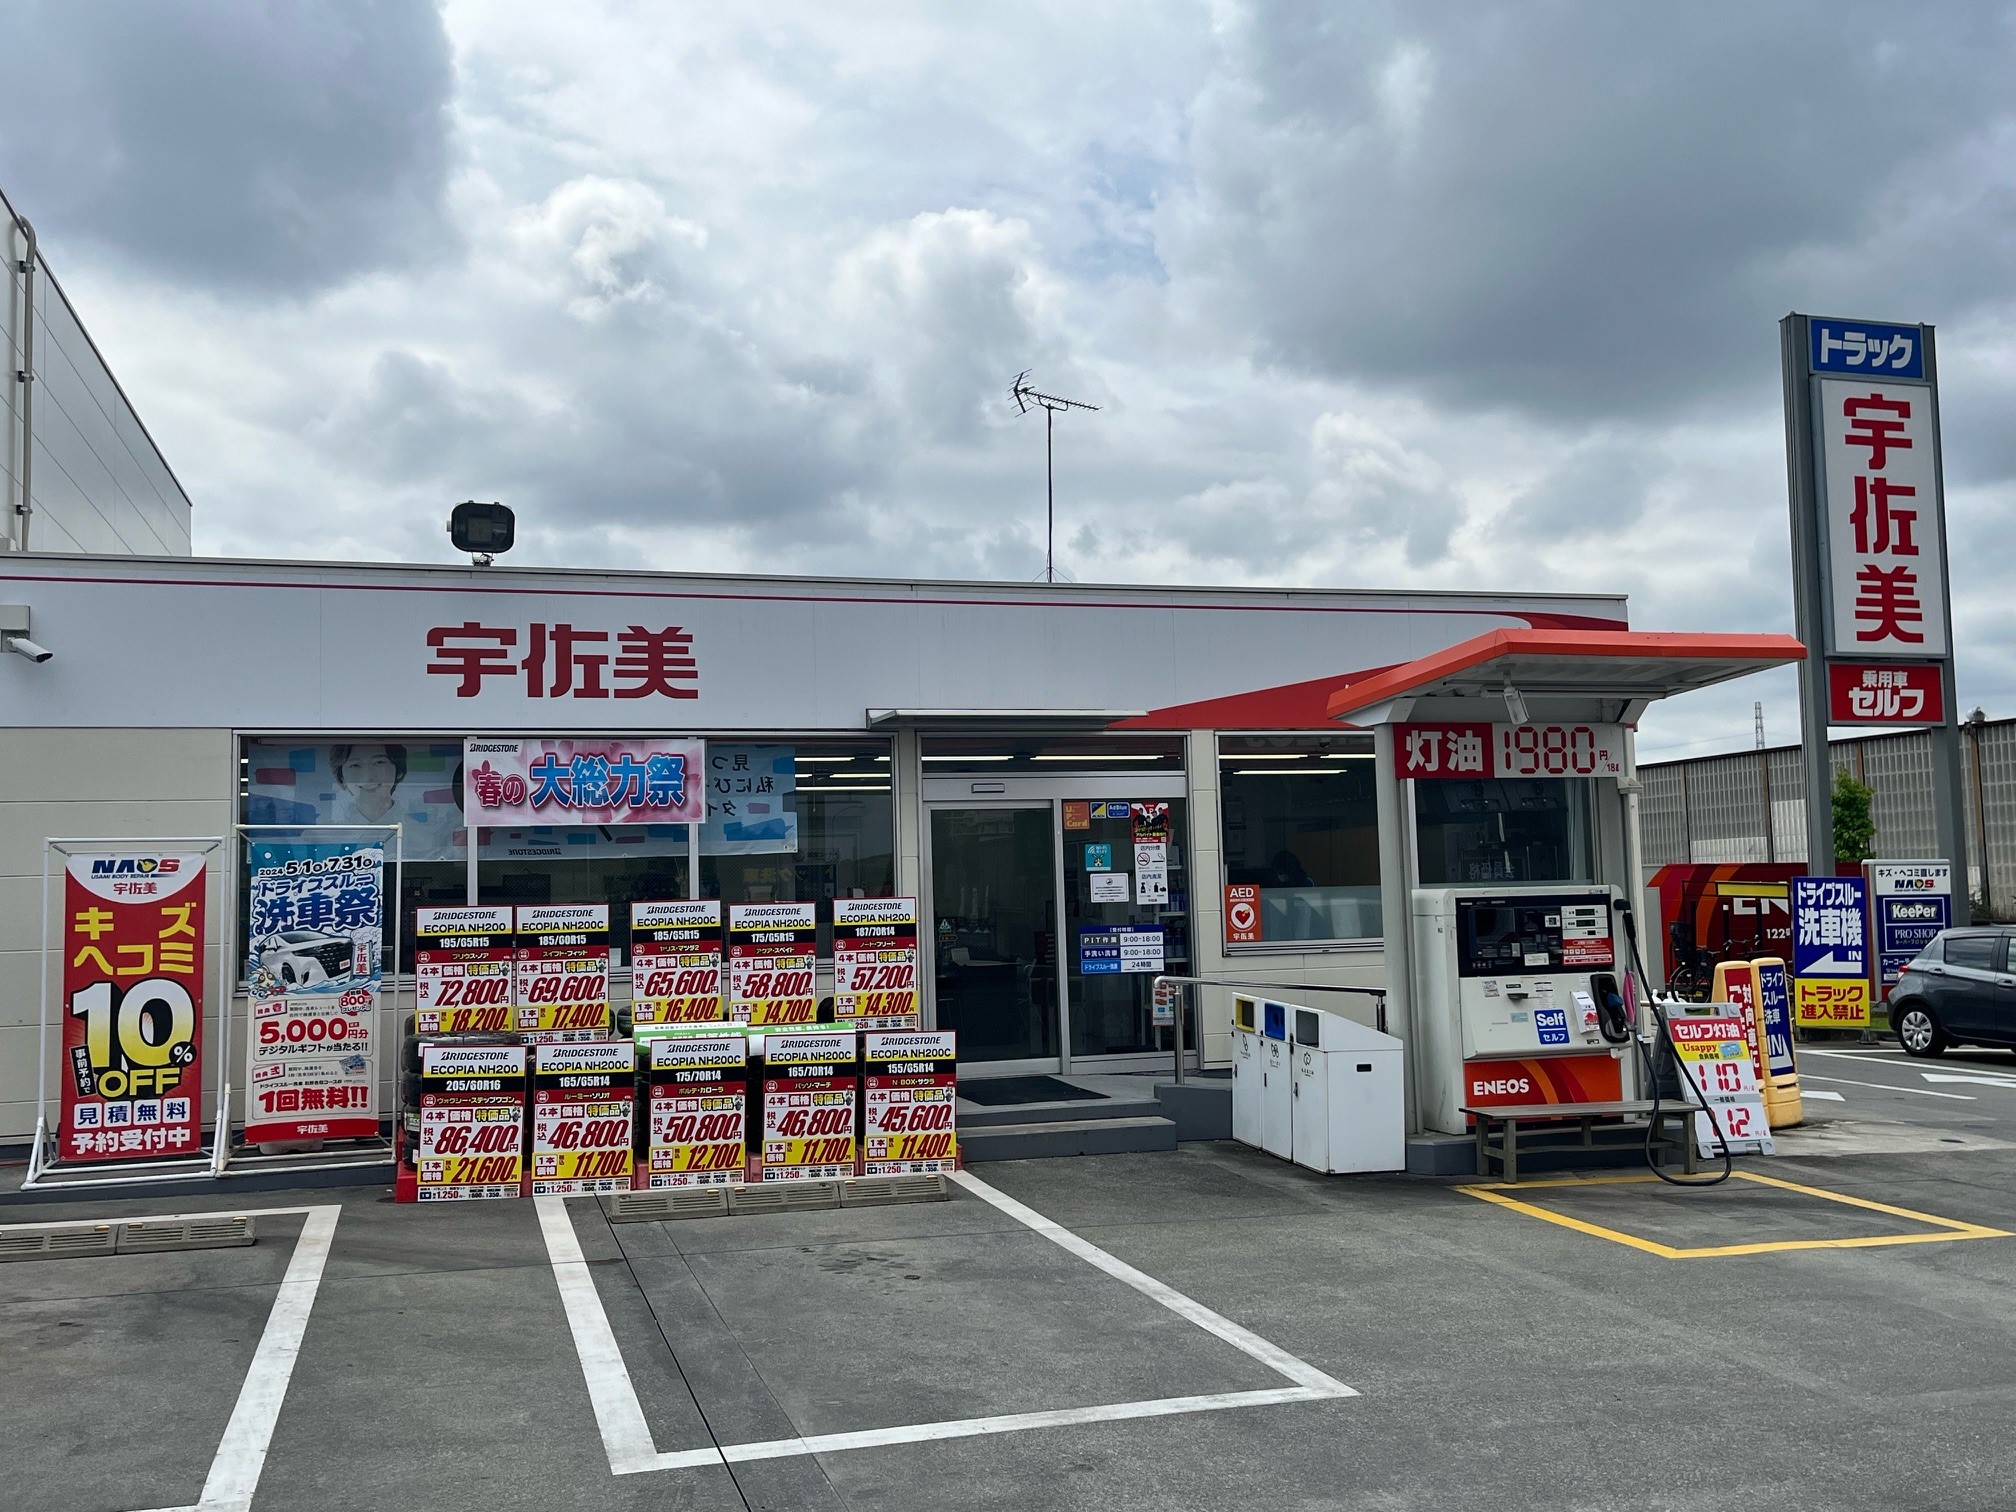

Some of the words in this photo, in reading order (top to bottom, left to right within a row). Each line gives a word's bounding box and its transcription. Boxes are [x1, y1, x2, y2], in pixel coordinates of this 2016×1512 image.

[1820, 328, 1912, 369] トラック
[1843, 393, 1924, 643] 宇佐美
[427, 622, 699, 699] 宇佐美
[1862, 670, 1908, 689] 乗用車
[1849, 687, 1924, 717] セルフ
[469, 743, 519, 753] BRIDGESTONE
[1405, 729, 1484, 772] 灯油
[1504, 726, 1596, 774] 1980
[477, 773, 525, 807] 春の
[531, 754, 686, 808] 大総力祭
[92, 858, 180, 874] NAOS
[260, 868, 284, 876] 2024
[113, 882, 158, 895] 宇佐美
[1895, 879, 1936, 888] NAOS
[1230, 887, 1254, 897] AED
[1797, 882, 1862, 905] ドライブスルー
[256, 887, 377, 934] 洗車祭
[647, 905, 706, 914] BRIDGESTONE
[848, 902, 902, 911] BRIDGESTONE
[1892, 904, 1937, 918] KeePer
[433, 911, 497, 920] BRIDGESTONE
[532, 909, 594, 918] BRIDGESTONE
[744, 908, 801, 917] BRIDGESTONE
[840, 914, 876, 923] ECOPIA
[878, 913, 911, 922] NH200
[75, 902, 197, 940] キズ
[522, 922, 560, 931] ECOPIA
[562, 921, 604, 930] NH200C
[637, 917, 674, 927] ECOPIA
[676, 916, 716, 925] NH200C
[735, 920, 770, 929] ECOPIA
[772, 919, 811, 928] NH200C
[424, 924, 465, 933] ECOPIA
[468, 923, 506, 932] NH200
[1798, 908, 1862, 946] 洗車機
[653, 930, 700, 941] 185/65R15
[751, 932, 795, 943] 175/65R15
[1895, 929, 1912, 938] PRO
[1914, 928, 1936, 938] SHOP
[440, 937, 489, 948] 195/65R15
[538, 935, 586, 946] 185/60R15
[74, 942, 194, 976] ヘコミ
[1848, 951, 1862, 961] IN
[1760, 973, 1784, 988] ドライブ
[1763, 991, 1785, 1006] スルー
[1801, 986, 1863, 1002] トラック
[1764, 1009, 1780, 1025] 洗車
[1801, 1004, 1864, 1020] 進入禁止
[1536, 1013, 1564, 1027] Self
[1675, 1023, 1740, 1039] セルフ灯油
[881, 1037, 941, 1046] BRIDGESTONE
[1542, 1033, 1566, 1042] セルフ
[667, 1043, 731, 1053] BRIDGESTONE
[780, 1039, 841, 1048] BRIDGESTONE
[1683, 1044, 1718, 1052] Usappy
[1767, 1034, 1783, 1056] IN
[441, 1052, 509, 1061] BRIDGESTONE
[552, 1048, 618, 1058] BRIDGESTONE
[770, 1053, 808, 1062] ECOPIA
[810, 1051, 852, 1061] NH200C
[871, 1049, 908, 1059] ECOPIA
[910, 1048, 951, 1058] NH200C
[541, 1061, 583, 1072] ECOPIA
[585, 1060, 629, 1071] NH200C
[656, 1057, 696, 1067] ECOPIA
[698, 1055, 741, 1066] NH200C
[430, 1065, 476, 1075] ECOPIA
[478, 1064, 519, 1074] NH200
[787, 1066, 834, 1077] 165/70R14
[887, 1063, 934, 1074] 155/65R14
[675, 1070, 722, 1082] 175/70R14
[98, 1067, 181, 1098] OFF
[446, 1079, 501, 1091] 205/60R16
[559, 1076, 610, 1088] 165/65R14
[1473, 1079, 1529, 1096] ENEOS
[77, 1101, 187, 1126] 見積無料
[71, 1127, 191, 1155] 予約受付中
